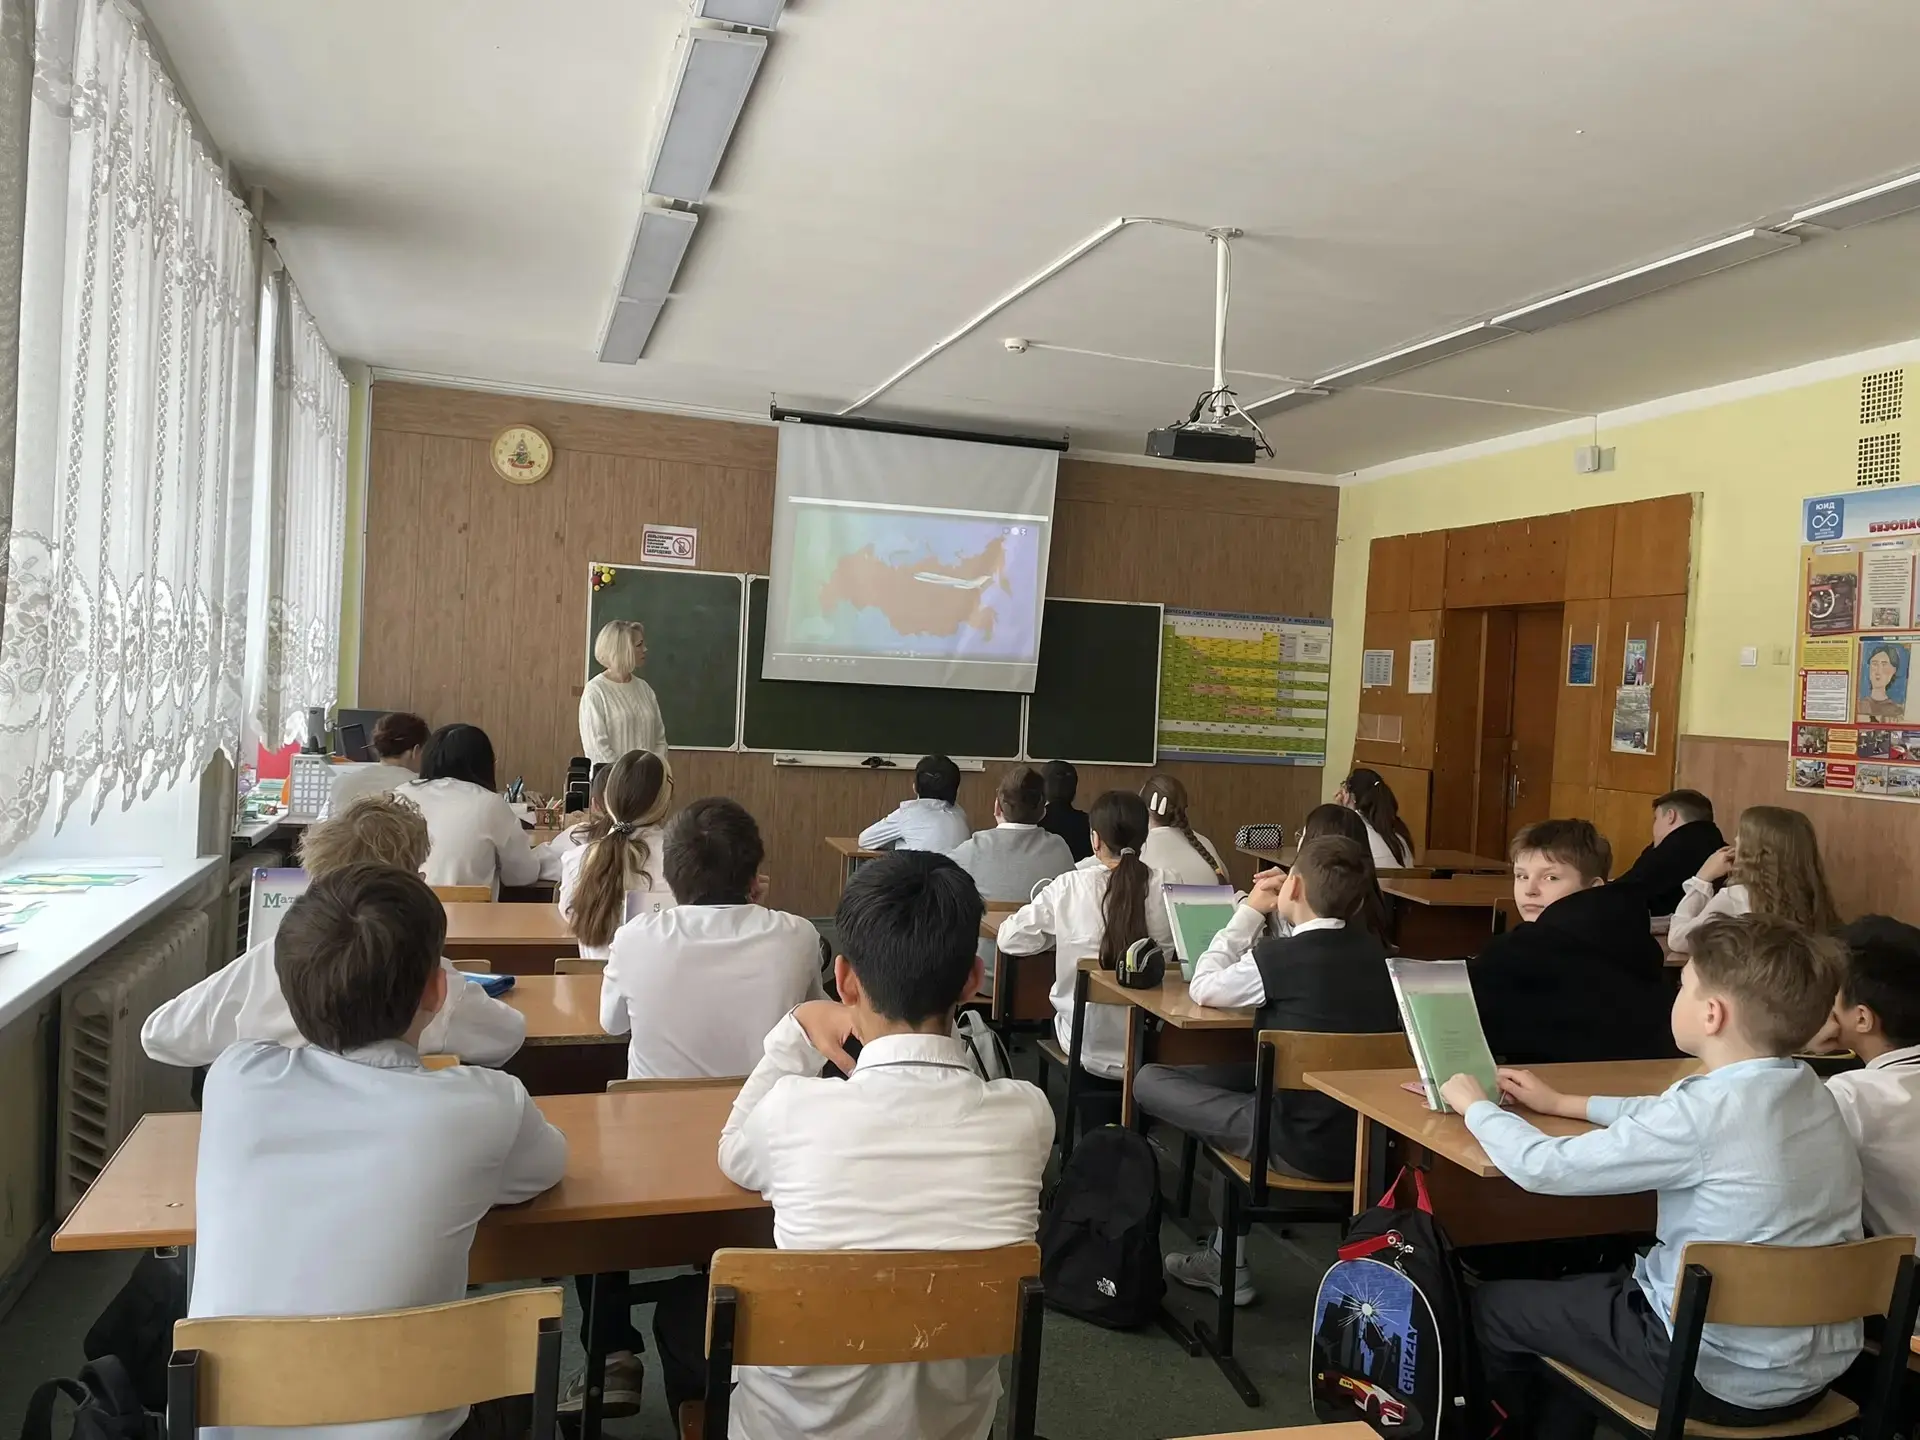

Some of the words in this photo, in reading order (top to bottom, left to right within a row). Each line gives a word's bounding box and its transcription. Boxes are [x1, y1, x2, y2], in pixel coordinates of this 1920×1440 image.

[1815, 502, 1835, 510] ЮИД
[262, 893, 295, 908] Мат
[1402, 1323, 1418, 1395] GRIZZLY
